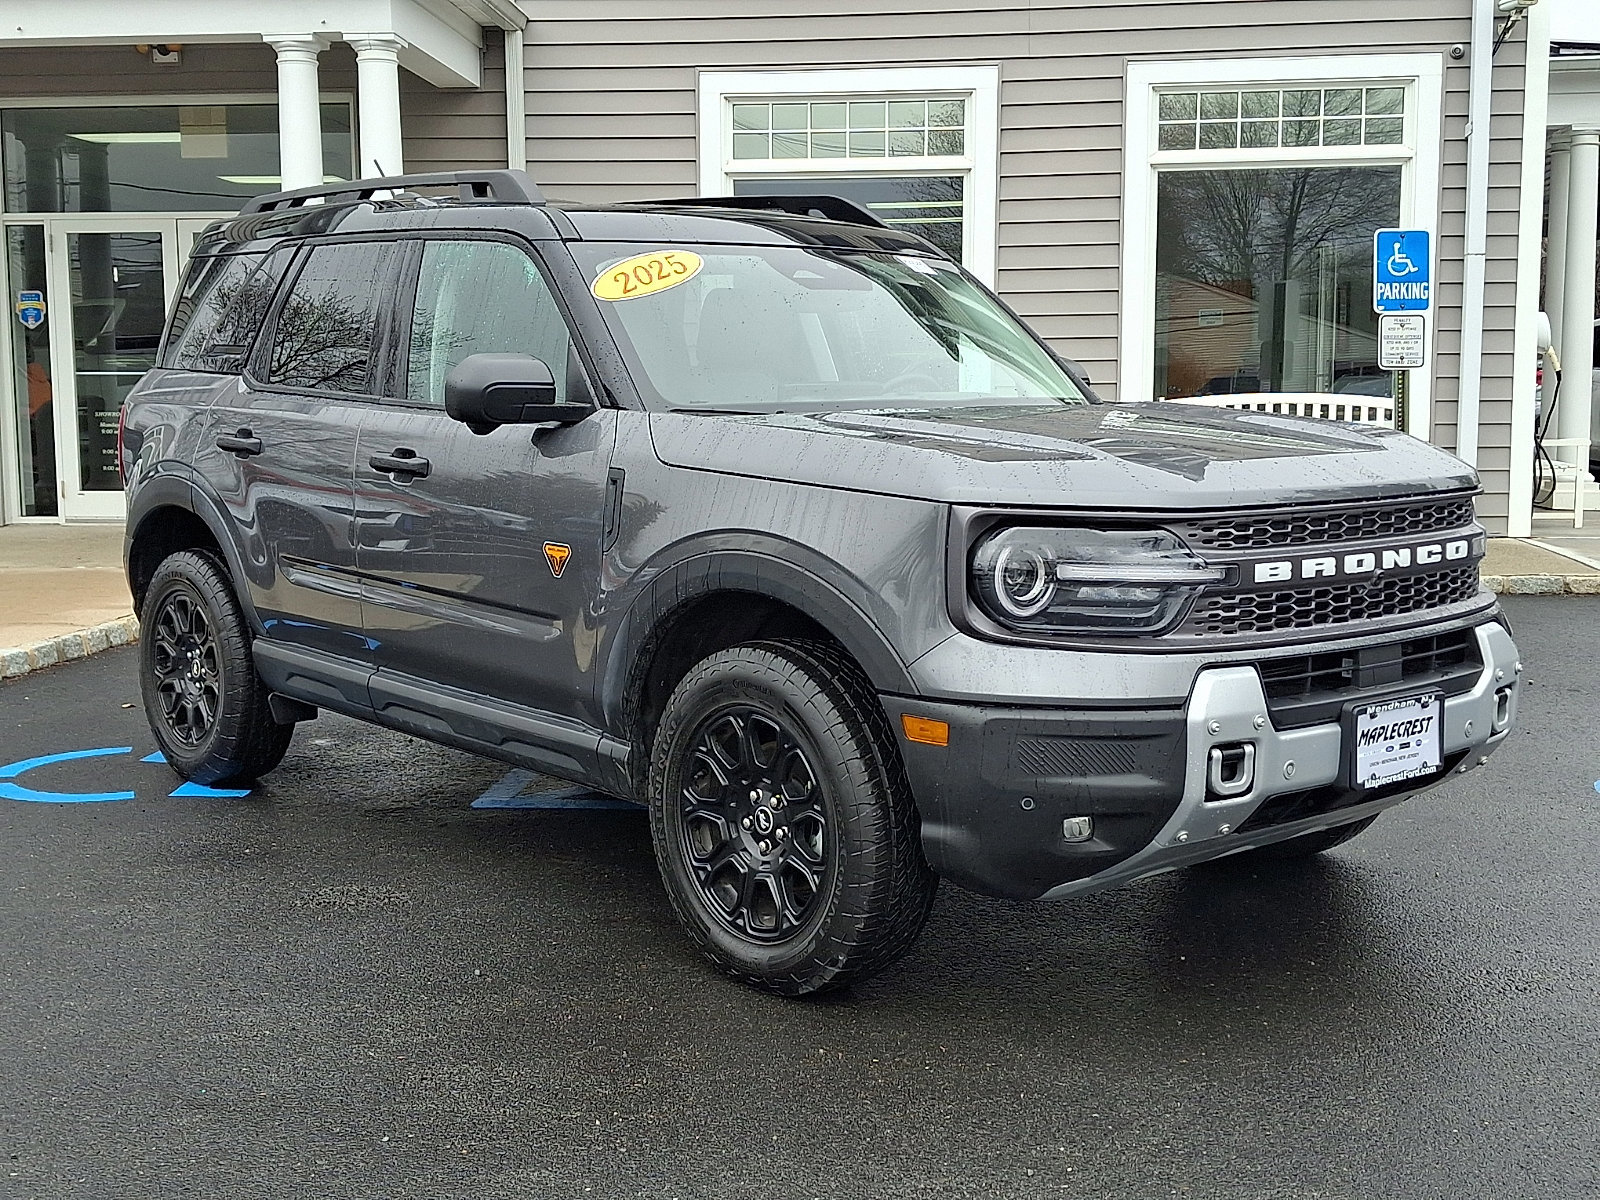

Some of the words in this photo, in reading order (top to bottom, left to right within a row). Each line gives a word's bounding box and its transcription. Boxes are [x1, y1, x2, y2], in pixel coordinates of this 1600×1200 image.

[614, 255, 687, 294] 2025
[1377, 281, 1429, 300] PARKING
[1254, 540, 1469, 583] BRONCO
[1421, 694, 1435, 704] NJ
[1357, 715, 1434, 748] MAPLECREST
[1364, 765, 1437, 789] MaplecrestFord.com
